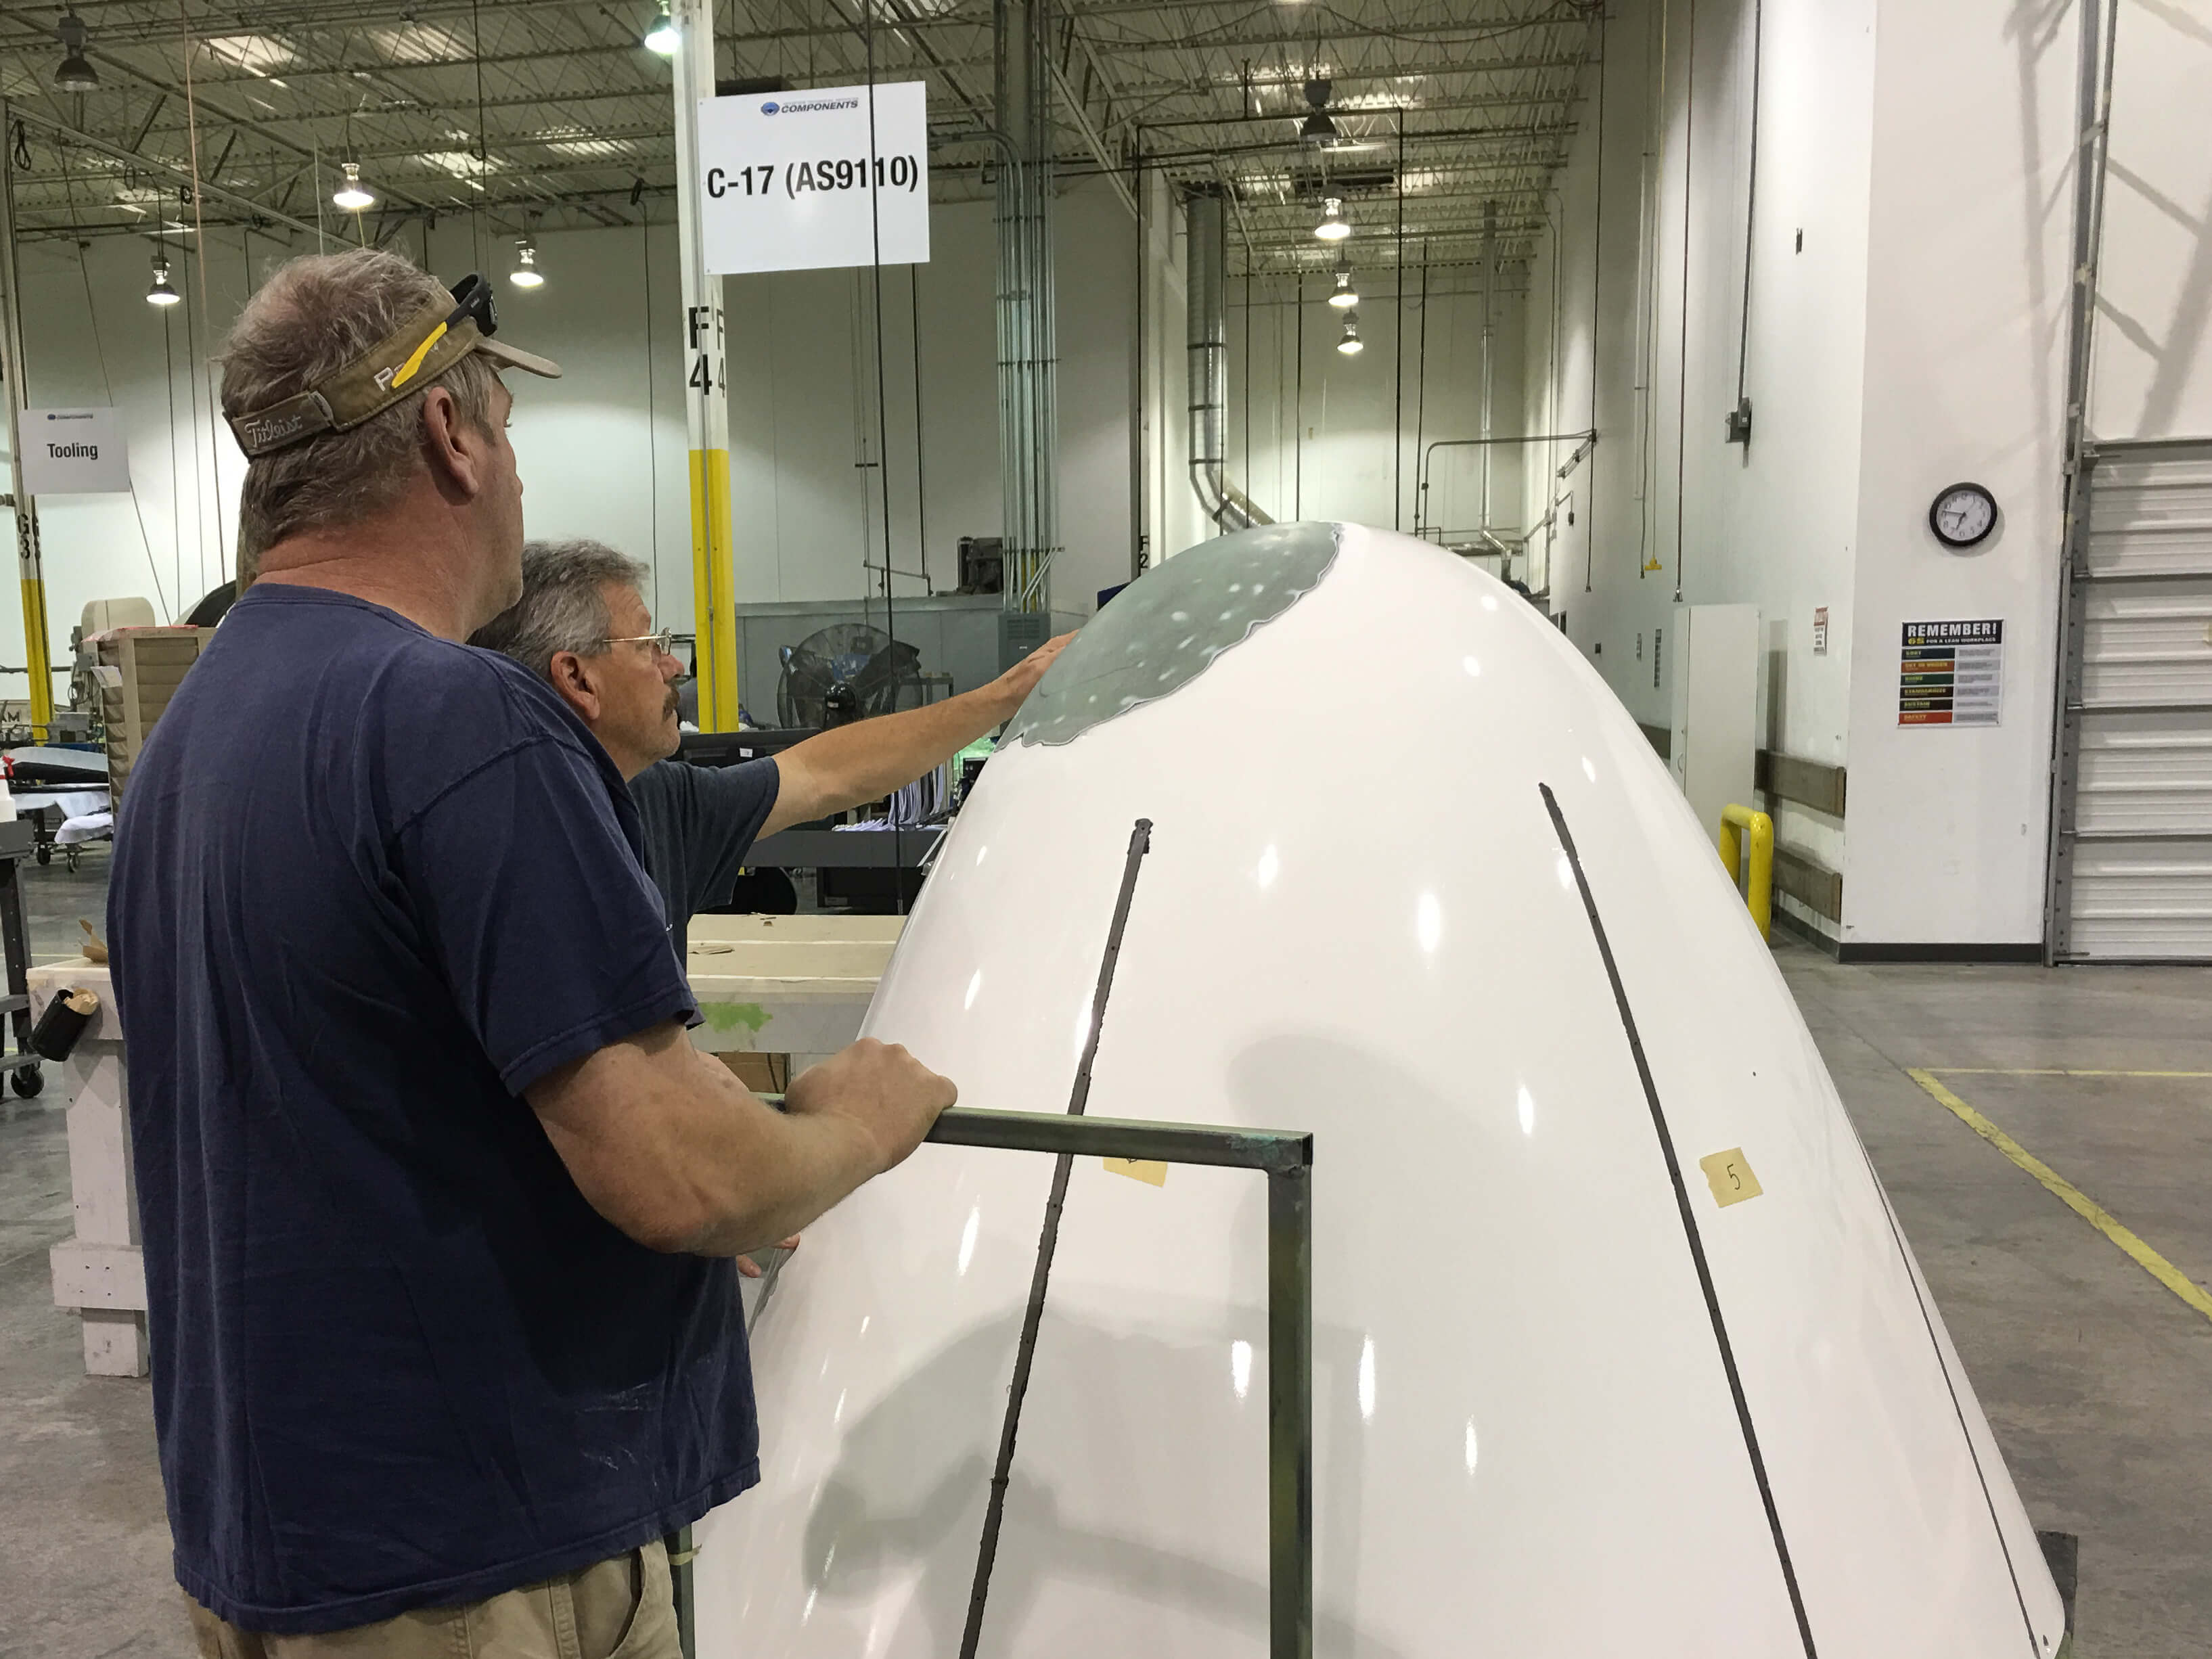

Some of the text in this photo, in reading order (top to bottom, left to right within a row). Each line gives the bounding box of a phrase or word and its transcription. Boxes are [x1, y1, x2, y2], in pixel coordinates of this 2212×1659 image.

[782, 99, 859, 113] COMPONENTS
[707, 154, 918, 200] C-17 (AS9110)
[688, 306, 709, 349] F
[689, 354, 712, 395] 4
[244, 414, 302, 447] Titleist
[47, 442, 98, 460] Tooling
[20, 539, 30, 559] 3
[1908, 622, 1997, 637] REMEMBER!
[1727, 1163, 1740, 1190] 5
